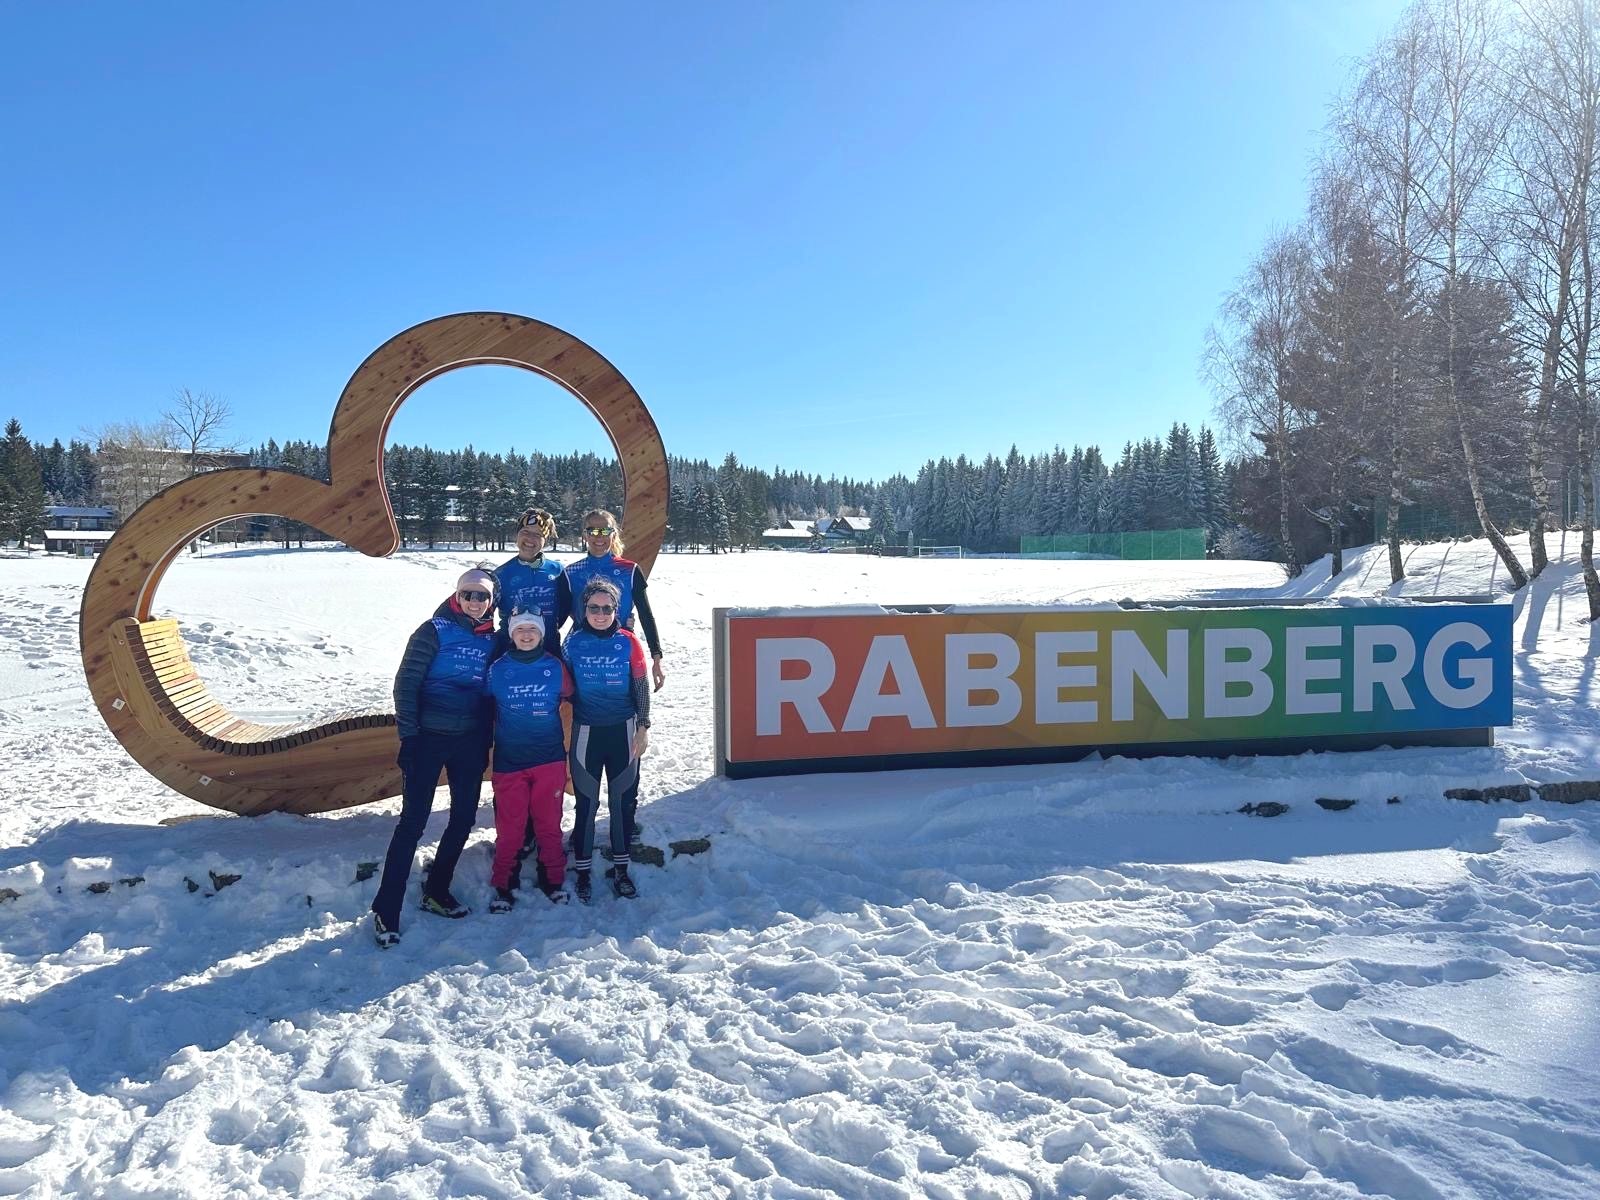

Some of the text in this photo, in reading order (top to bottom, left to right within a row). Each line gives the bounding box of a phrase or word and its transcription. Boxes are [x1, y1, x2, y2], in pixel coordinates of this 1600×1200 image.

[580, 655, 620, 665] TSV
[754, 621, 1494, 737] RABENBERG
[508, 684, 548, 694] TSV
